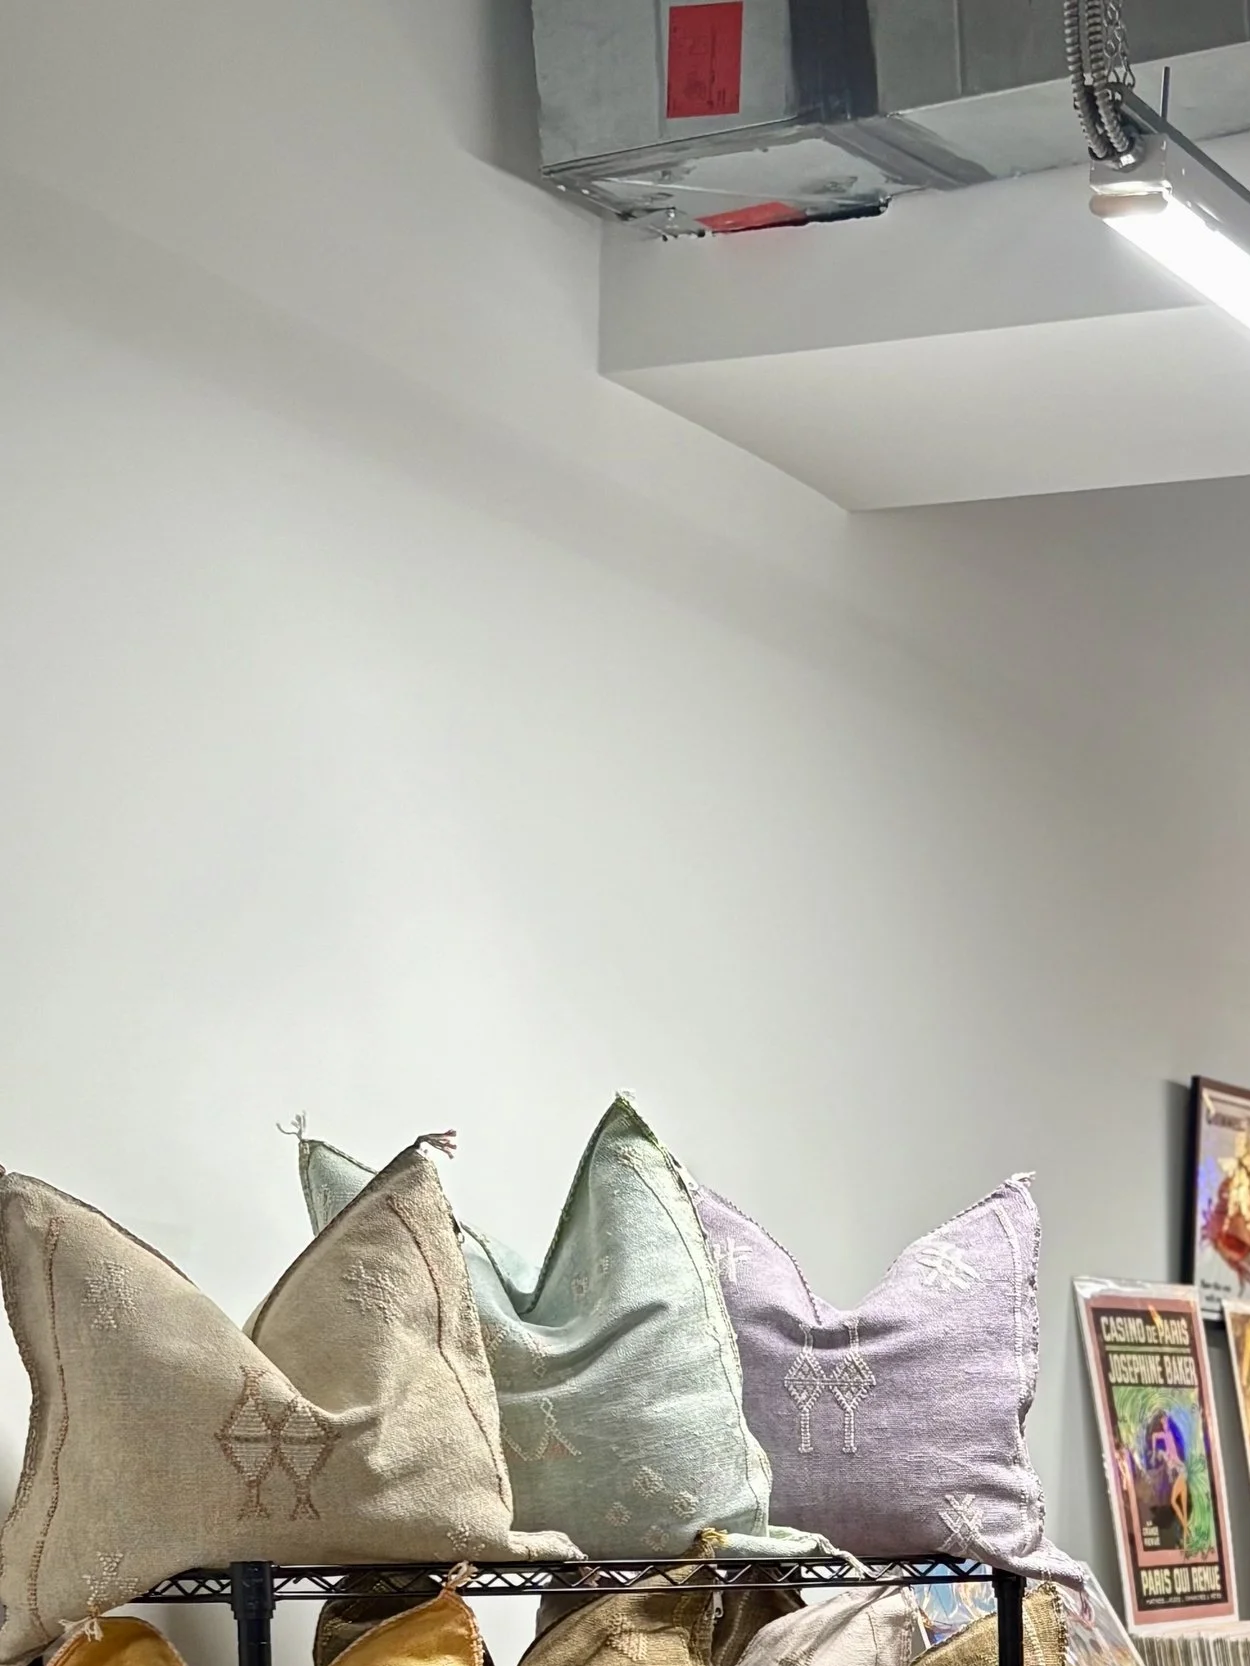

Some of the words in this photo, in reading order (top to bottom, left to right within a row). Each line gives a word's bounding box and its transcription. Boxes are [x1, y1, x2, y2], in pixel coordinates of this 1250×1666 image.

[1100, 1316, 1146, 1343] CASINO
[1145, 1325, 1158, 1343] DE
[1157, 1318, 1190, 1346] PARIS
[1108, 1353, 1164, 1384] JOSEPHINE
[1162, 1356, 1198, 1385] BAKER
[1140, 1568, 1172, 1597] PARIS
[1173, 1567, 1191, 1594] QUI
